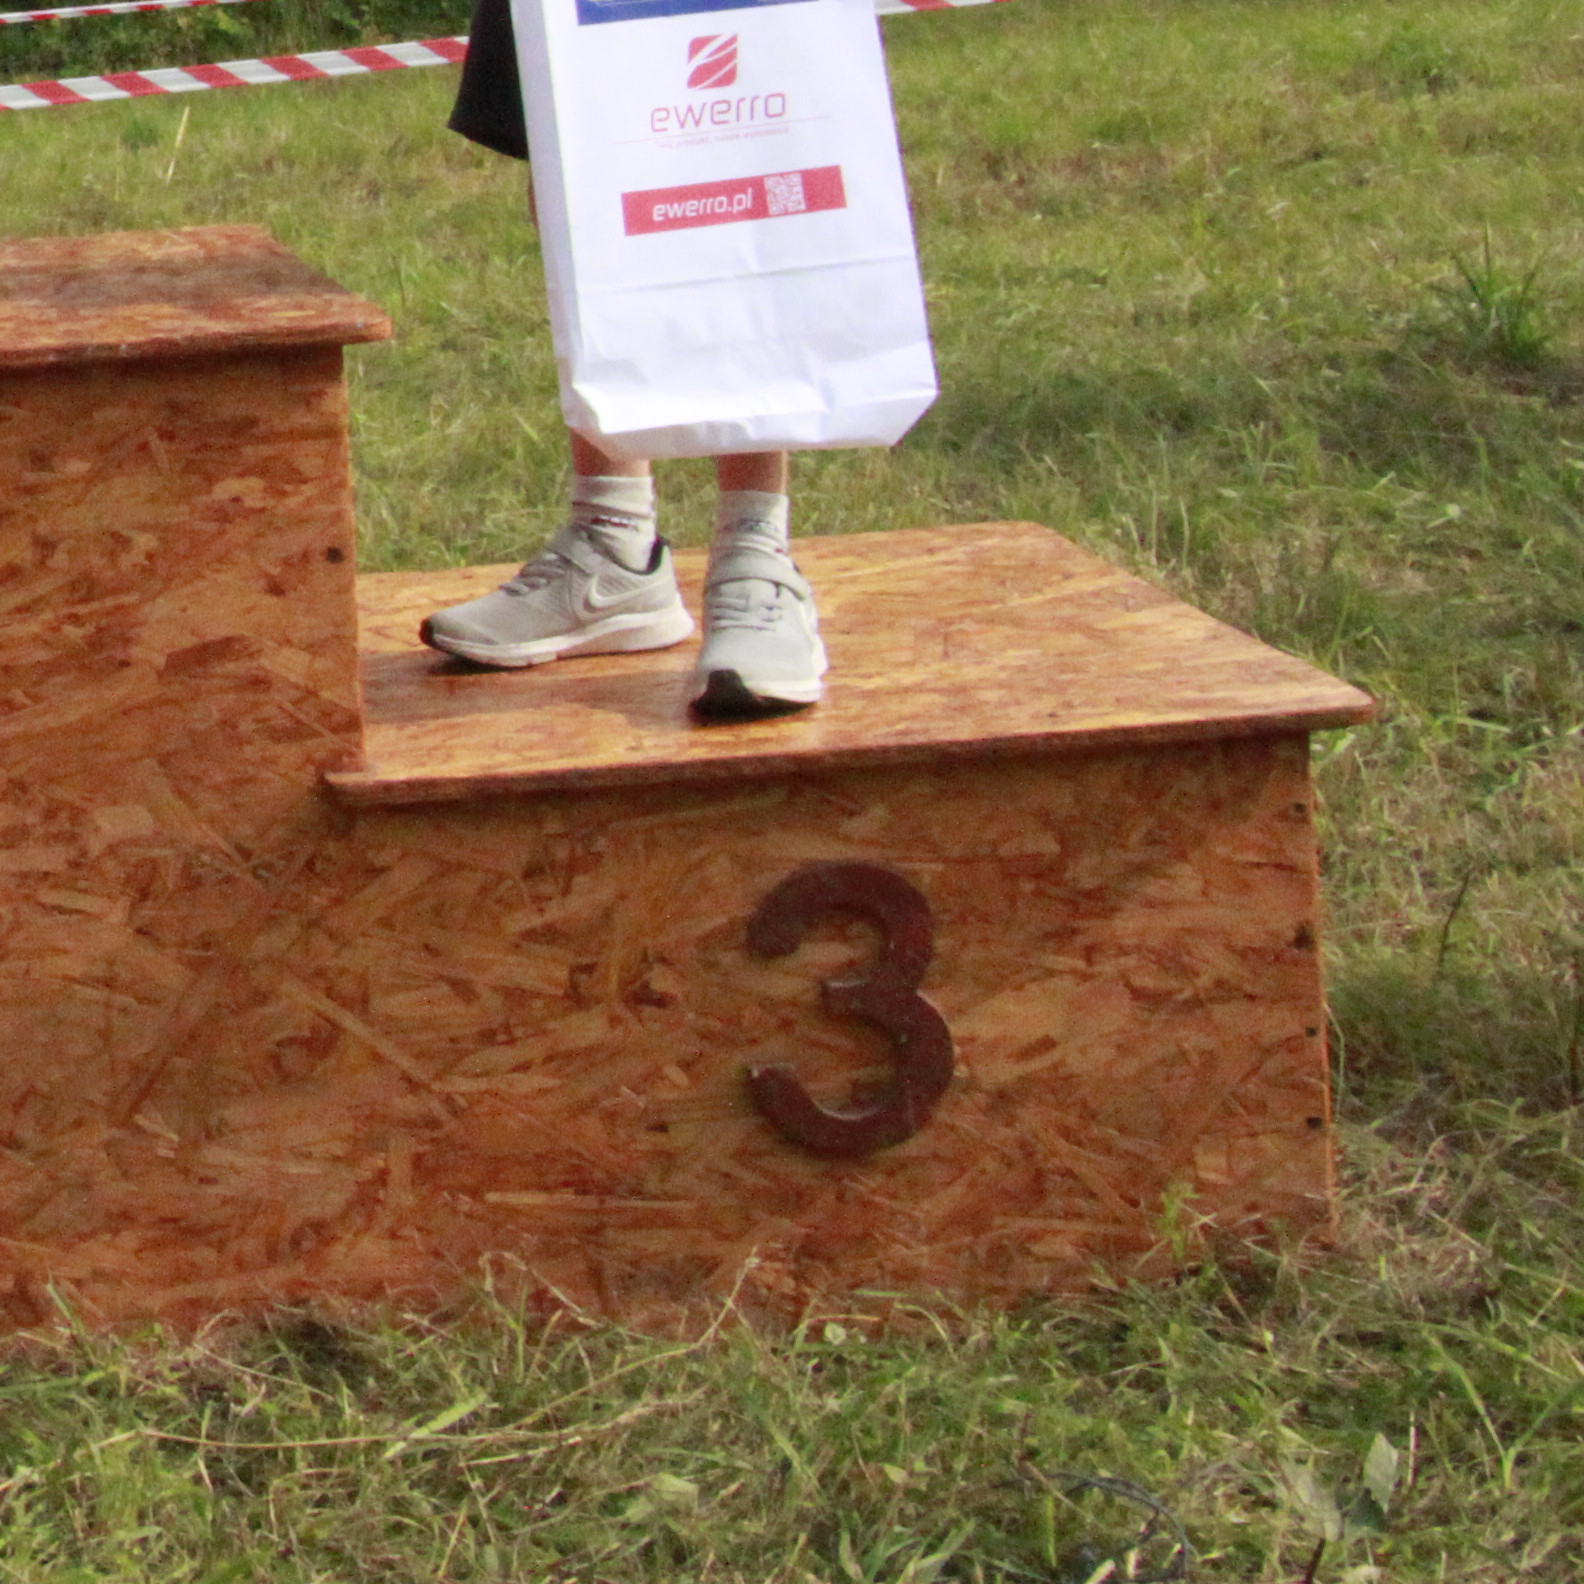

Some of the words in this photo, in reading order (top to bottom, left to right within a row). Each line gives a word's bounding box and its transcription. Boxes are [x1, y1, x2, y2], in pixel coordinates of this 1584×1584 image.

[650, 92, 786, 132] ewerro
[652, 186, 753, 222] ewerro.pl
[744, 859, 955, 1162] 3
